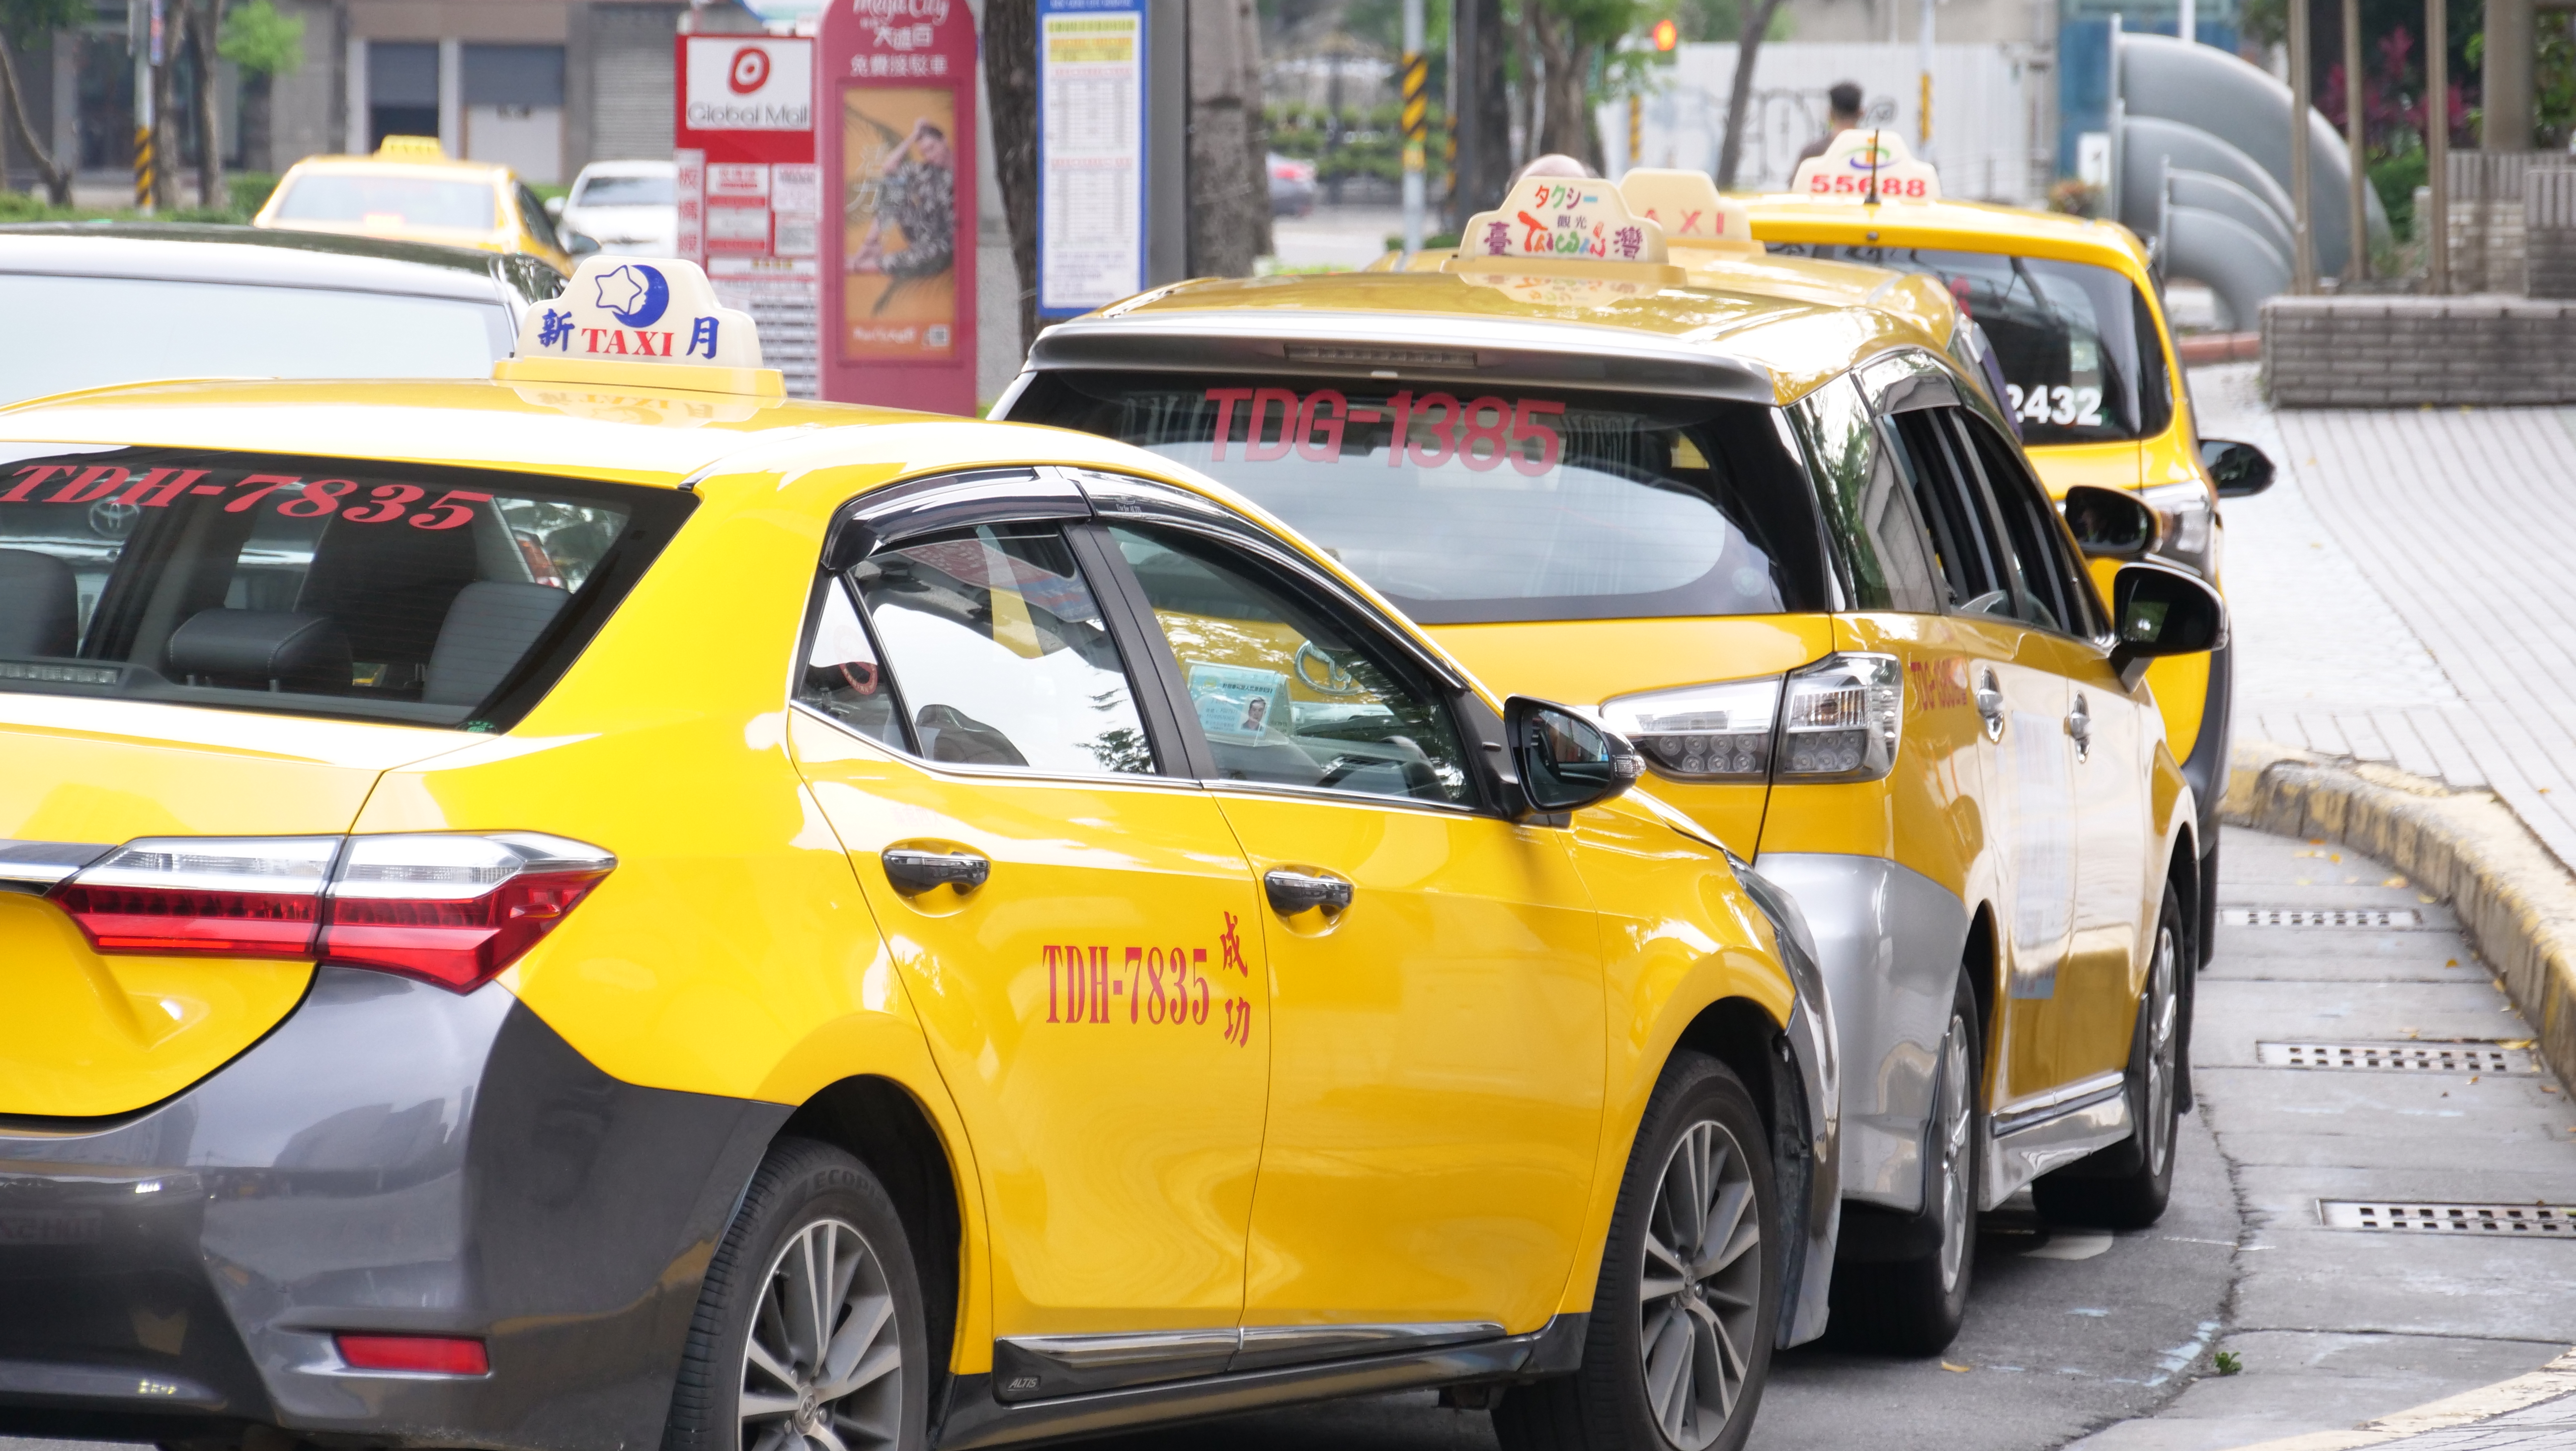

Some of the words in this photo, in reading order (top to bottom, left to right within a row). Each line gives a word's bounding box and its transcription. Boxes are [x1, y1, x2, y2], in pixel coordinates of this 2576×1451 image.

[688, 101, 759, 126] Global
[765, 102, 808, 126] Mall
[1535, 185, 1598, 209] タクシー
[1811, 175, 1926, 197] 55688
[1557, 215, 1587, 229] 觀光
[537, 308, 575, 352] 新
[581, 327, 674, 357] TAXI
[686, 317, 720, 359] 月
[1205, 388, 1566, 477] TDG-1385
[2, 465, 493, 530] TDH-7835
[1043, 945, 1209, 1025] TDH-7835
[1219, 911, 1251, 1048] 成功
[1009, 1378, 1038, 1388] ALTIS
